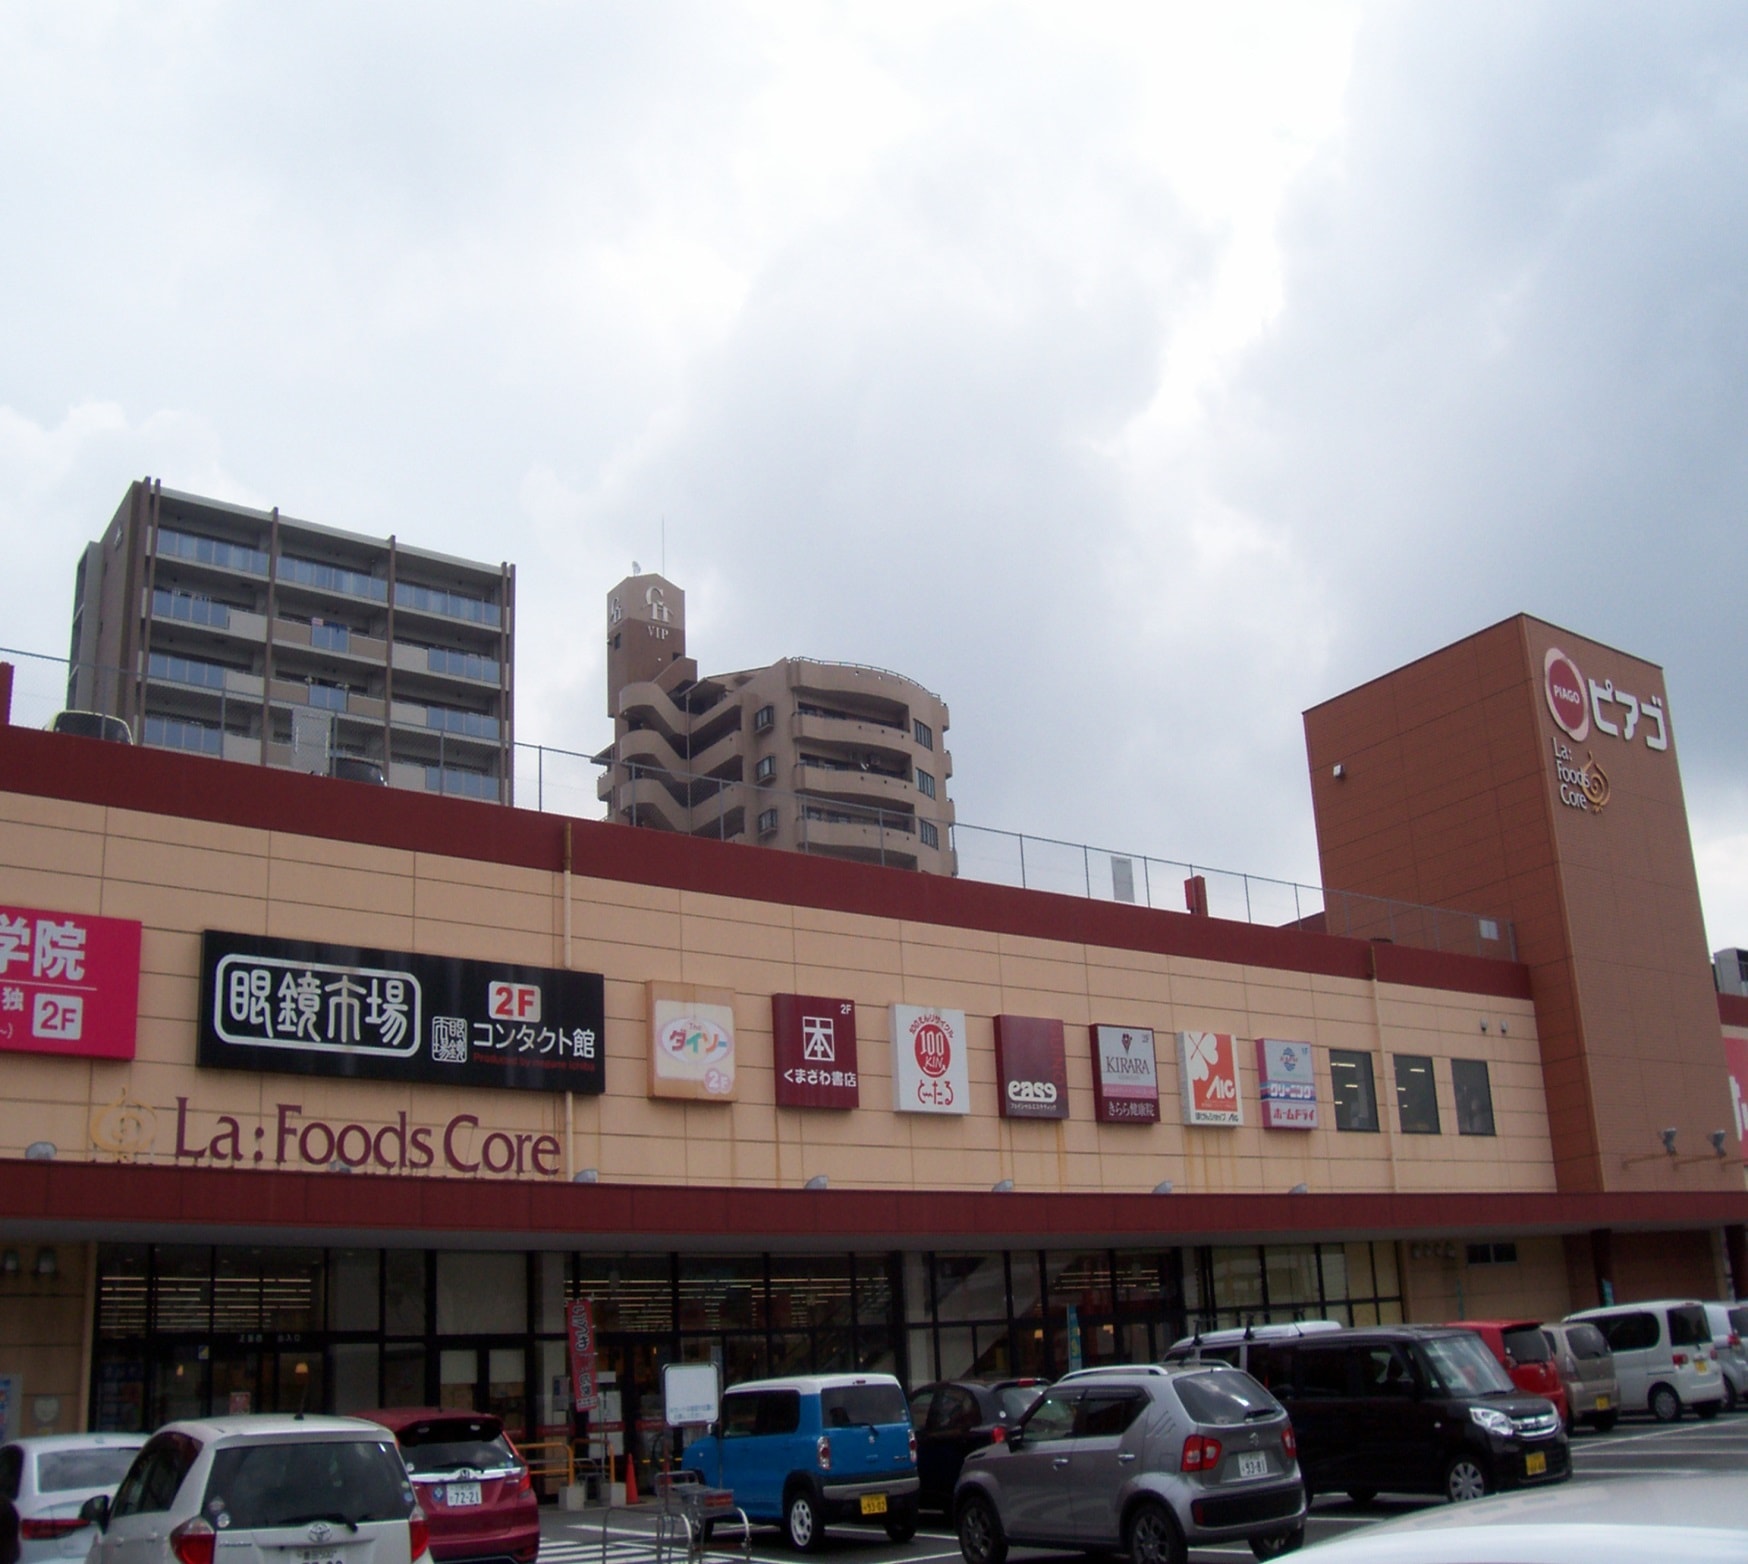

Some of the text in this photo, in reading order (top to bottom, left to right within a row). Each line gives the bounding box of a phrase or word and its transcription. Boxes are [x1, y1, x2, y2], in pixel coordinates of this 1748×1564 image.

[647, 625, 669, 640] VIP
[1553, 685, 1581, 704] PIAGO
[1588, 678, 1668, 751] ピアゴ
[1552, 736, 1573, 761] La:
[1556, 760, 1591, 787] Foods
[1560, 783, 1587, 809] Core
[230, 969, 408, 1046] 眼鏡市場
[495, 986, 535, 1017] 2F
[840, 1004, 852, 1014] 2F
[40, 1001, 77, 1031] 2F
[473, 1022, 595, 1058] コンタクト館
[669, 1029, 728, 1053] ダイソー
[920, 1031, 944, 1056] 100
[924, 1055, 944, 1068] KIN
[1106, 1056, 1150, 1075] KIRARA
[708, 1071, 729, 1089] 2F
[784, 1068, 857, 1087] くまざわ書店
[1206, 1074, 1235, 1099] AIG
[1008, 1080, 1057, 1103] ease
[1270, 1083, 1312, 1099] クリーニング
[1273, 1107, 1315, 1121] ホームドライ
